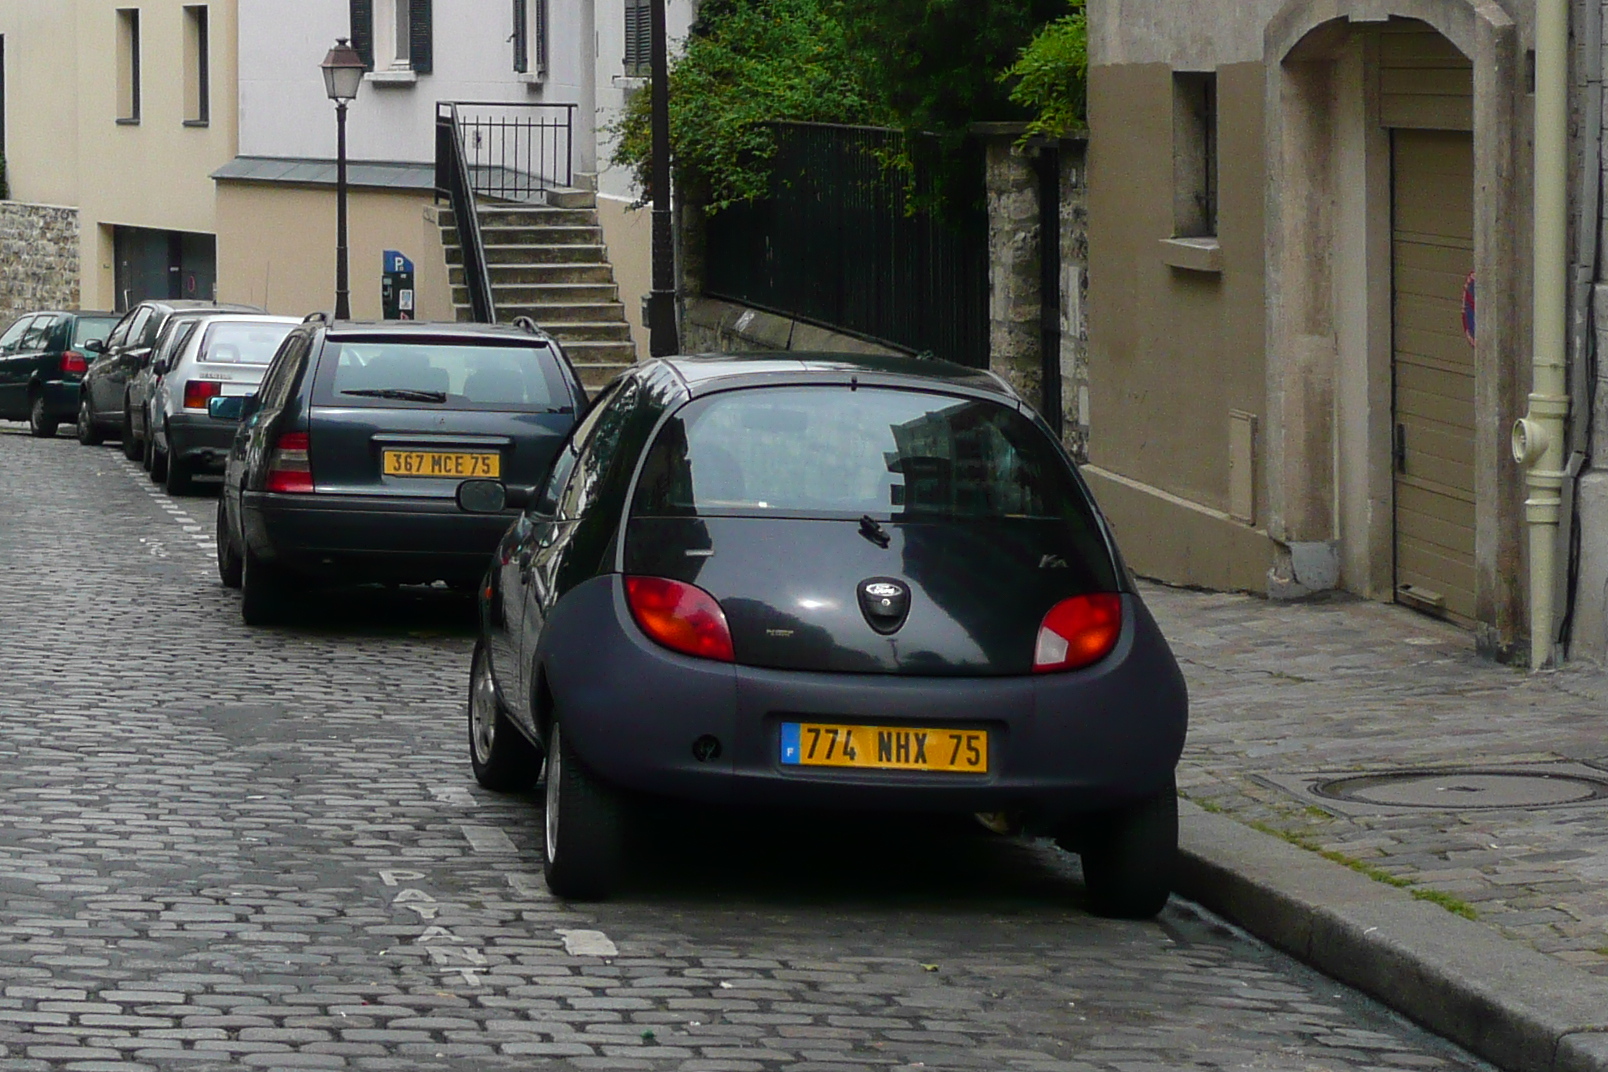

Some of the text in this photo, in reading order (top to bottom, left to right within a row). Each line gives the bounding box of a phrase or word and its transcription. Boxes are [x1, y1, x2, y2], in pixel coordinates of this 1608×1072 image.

[395, 257, 404, 272] P
[393, 453, 491, 474] 367 MCE 75
[806, 728, 857, 761] 774
[878, 731, 928, 764] NHX
[948, 734, 981, 766] 75
